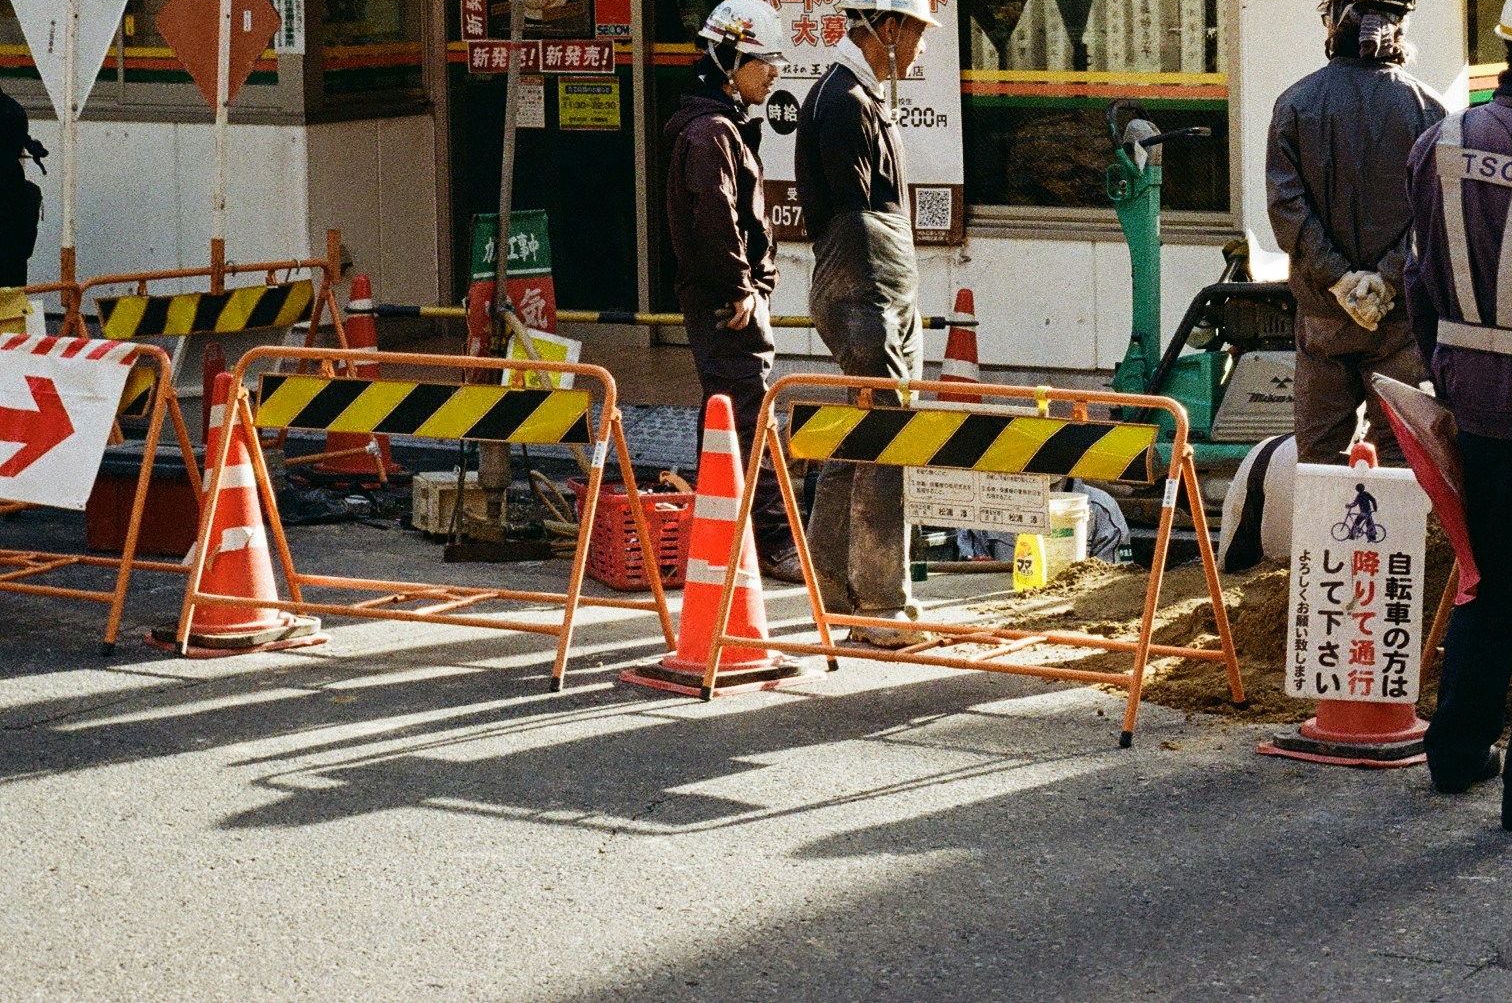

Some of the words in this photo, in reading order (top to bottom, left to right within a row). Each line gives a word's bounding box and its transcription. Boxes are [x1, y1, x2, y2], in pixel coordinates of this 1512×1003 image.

[545, 44, 609, 67] 新発売!
[768, 103, 798, 122] 時給
[898, 107, 947, 128] 200円
[1293, 549, 1312, 692] よろしくお願い致します
[1315, 549, 1345, 695] して下さい
[1347, 550, 1381, 697] 降りて通行
[1382, 551, 1413, 699] 自転車の方は
